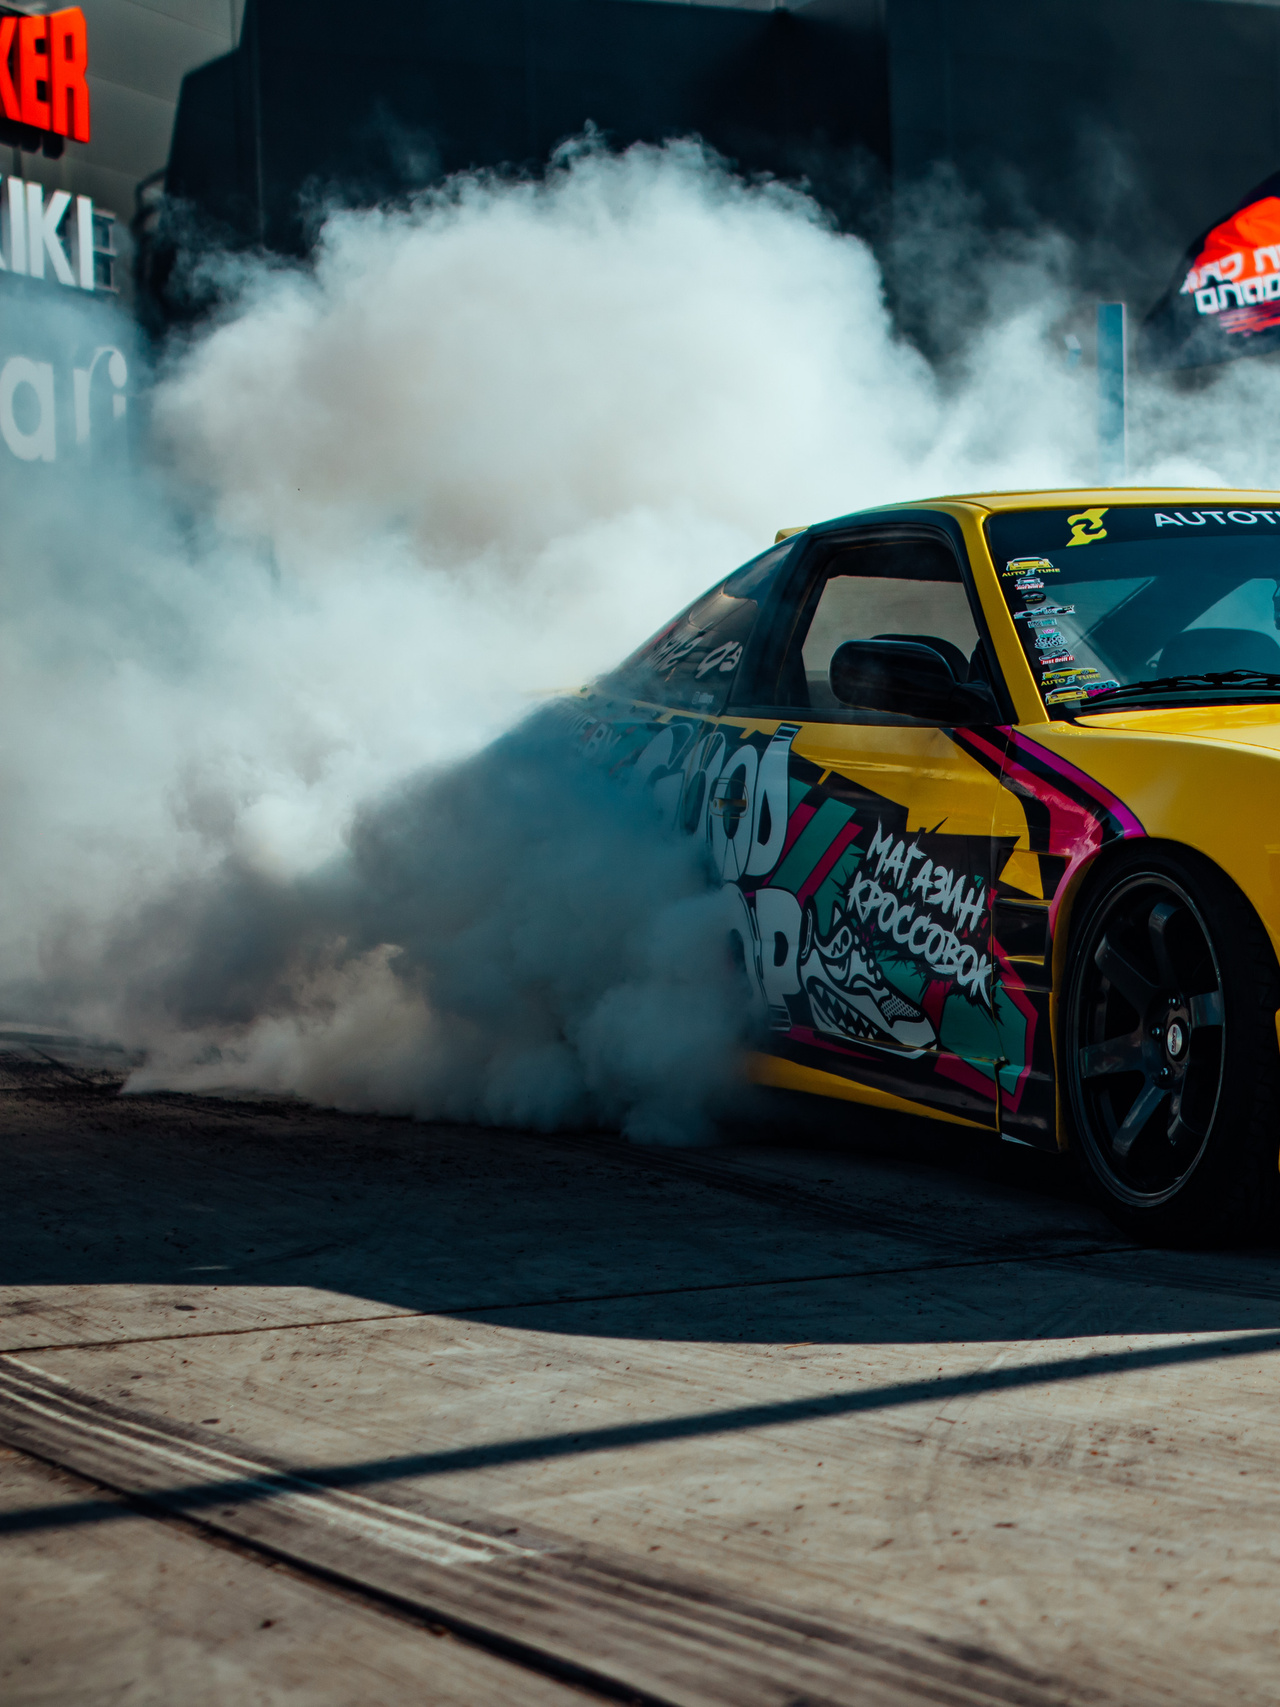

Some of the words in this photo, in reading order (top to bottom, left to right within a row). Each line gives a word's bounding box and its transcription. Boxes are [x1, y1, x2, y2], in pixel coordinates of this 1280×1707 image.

[0, 173, 95, 291] IKI
[1041, 678, 1065, 686] AUTO
[868, 818, 986, 931] МАГАЗИН
[846, 871, 993, 1011] КРОССОВОК
